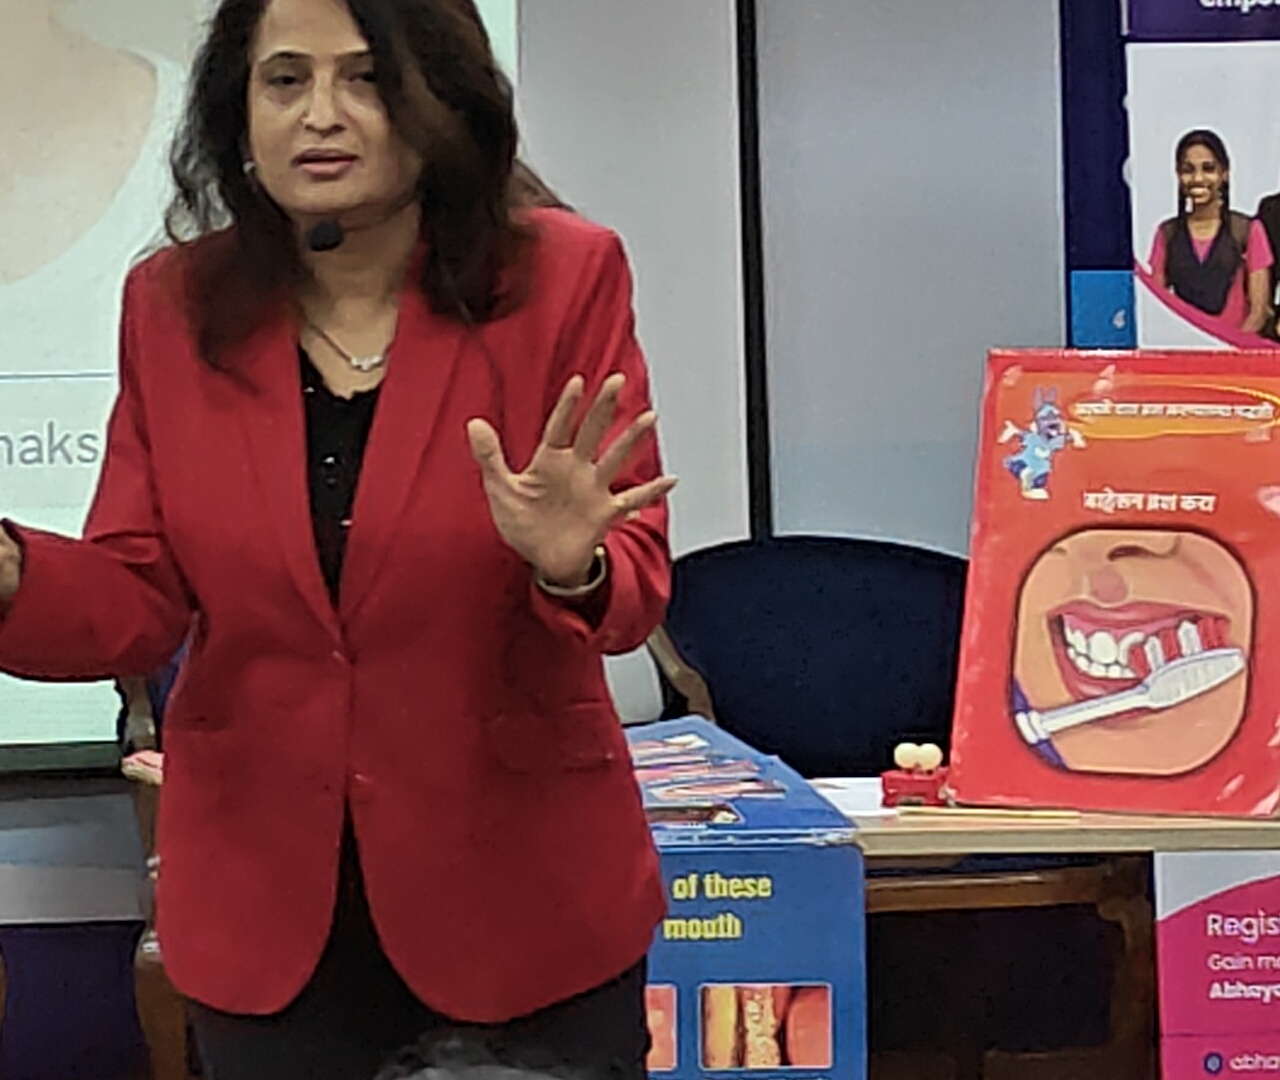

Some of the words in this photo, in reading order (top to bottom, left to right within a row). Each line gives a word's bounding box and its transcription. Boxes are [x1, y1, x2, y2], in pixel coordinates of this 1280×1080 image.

[672, 873, 699, 900] of
[703, 872, 773, 899] these
[663, 912, 743, 940] mouth
[1207, 953, 1254, 971] Gain
